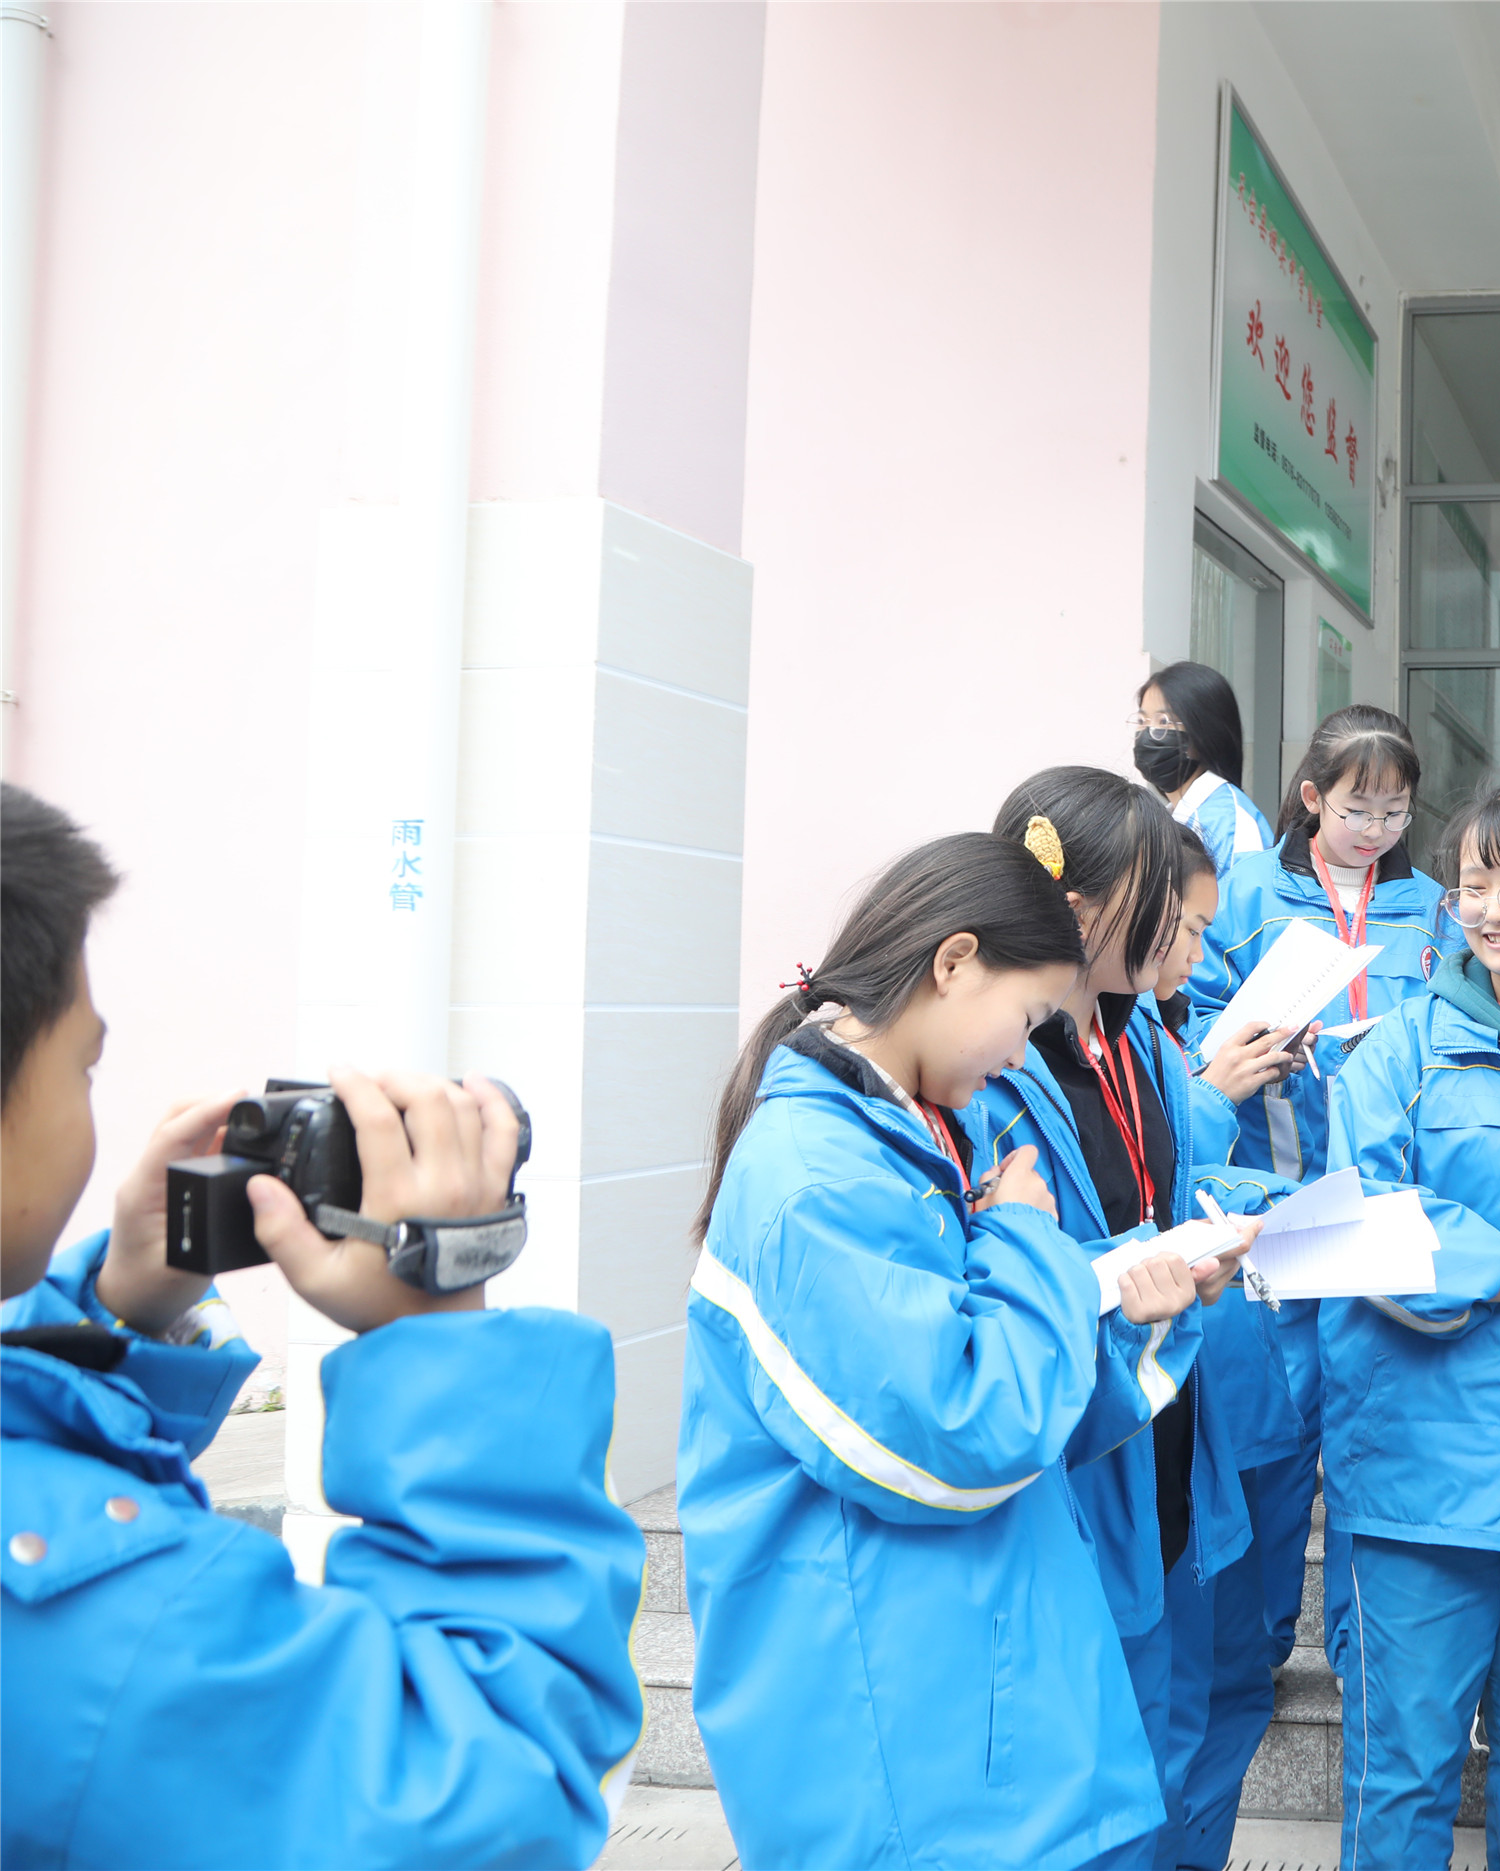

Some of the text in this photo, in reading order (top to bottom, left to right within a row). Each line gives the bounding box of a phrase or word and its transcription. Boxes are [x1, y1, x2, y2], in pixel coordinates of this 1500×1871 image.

[1246, 299, 1358, 488] 欢迎您监督
[389, 819, 424, 912] 雨水管
